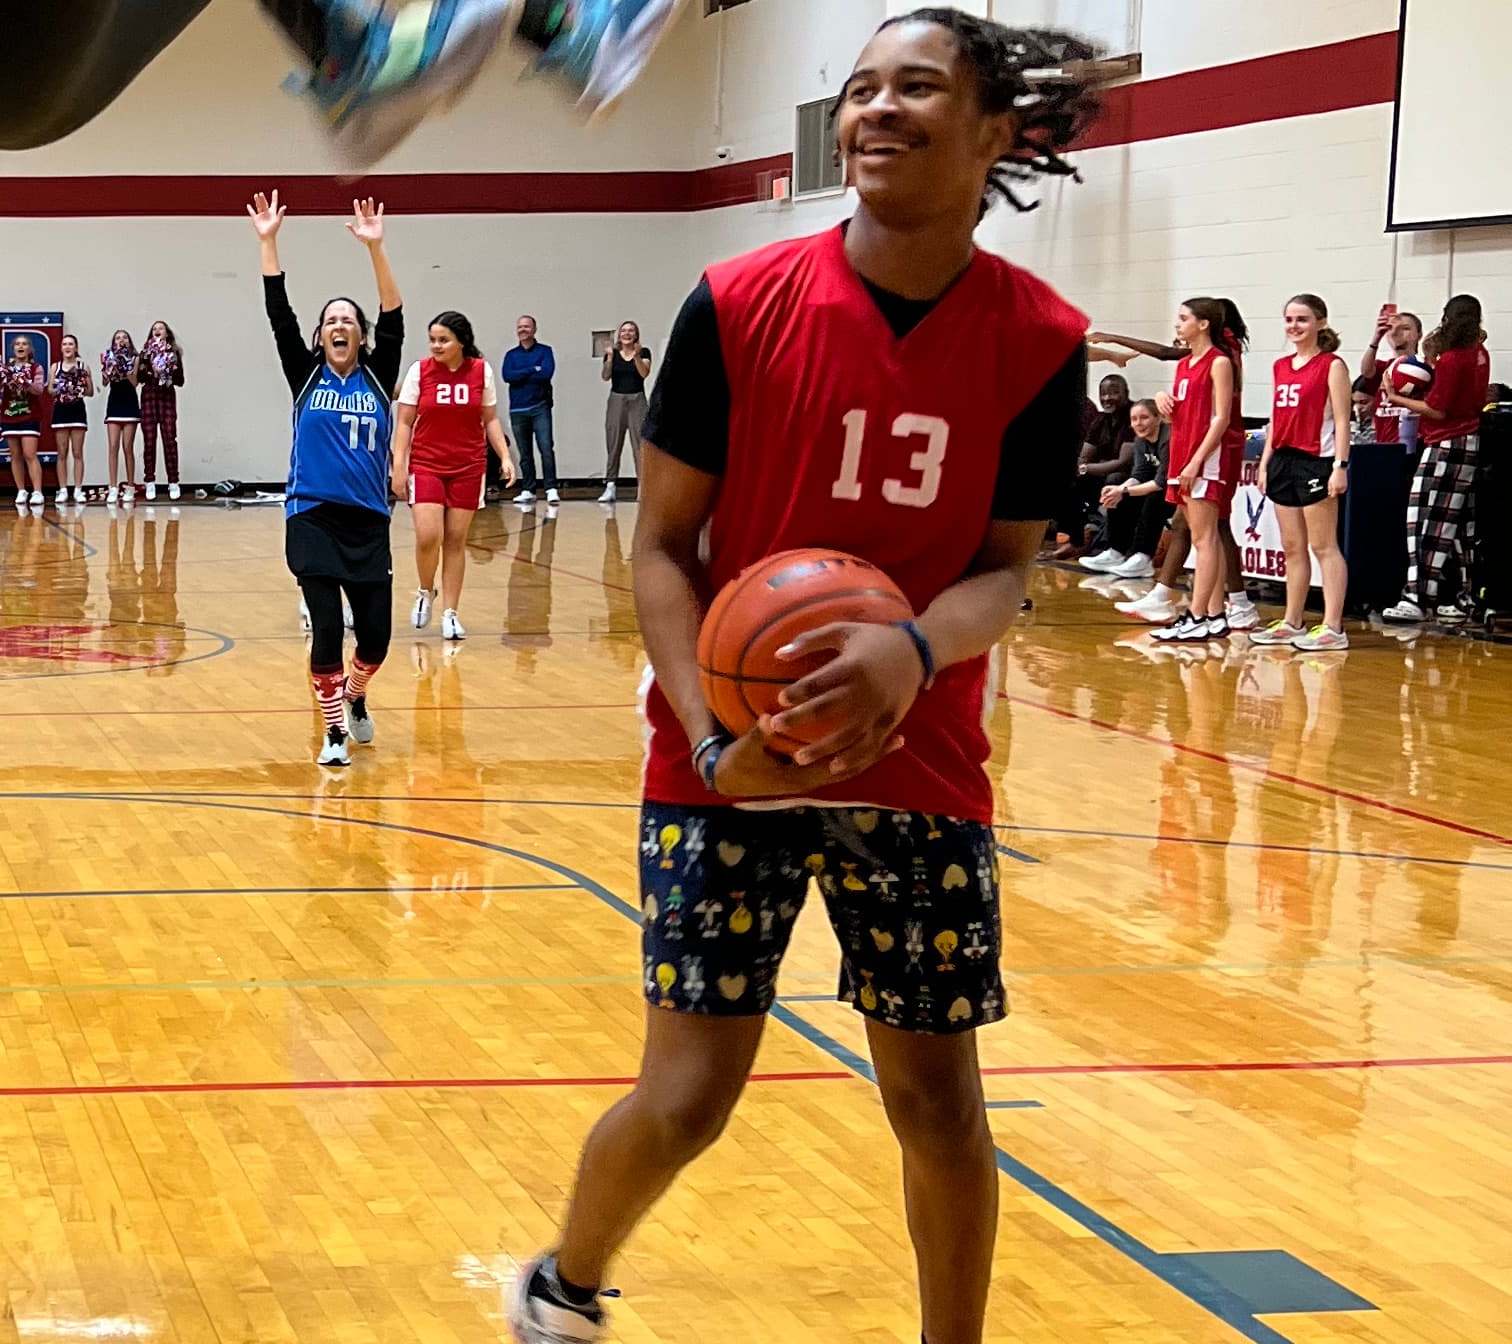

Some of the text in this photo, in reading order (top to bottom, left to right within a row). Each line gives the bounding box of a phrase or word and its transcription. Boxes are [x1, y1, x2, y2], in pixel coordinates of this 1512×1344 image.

[310, 388, 378, 414] DALLAS
[436, 383, 469, 405] 20
[1276, 384, 1301, 407] 35
[341, 414, 378, 452] 77
[831, 408, 950, 509] 13
